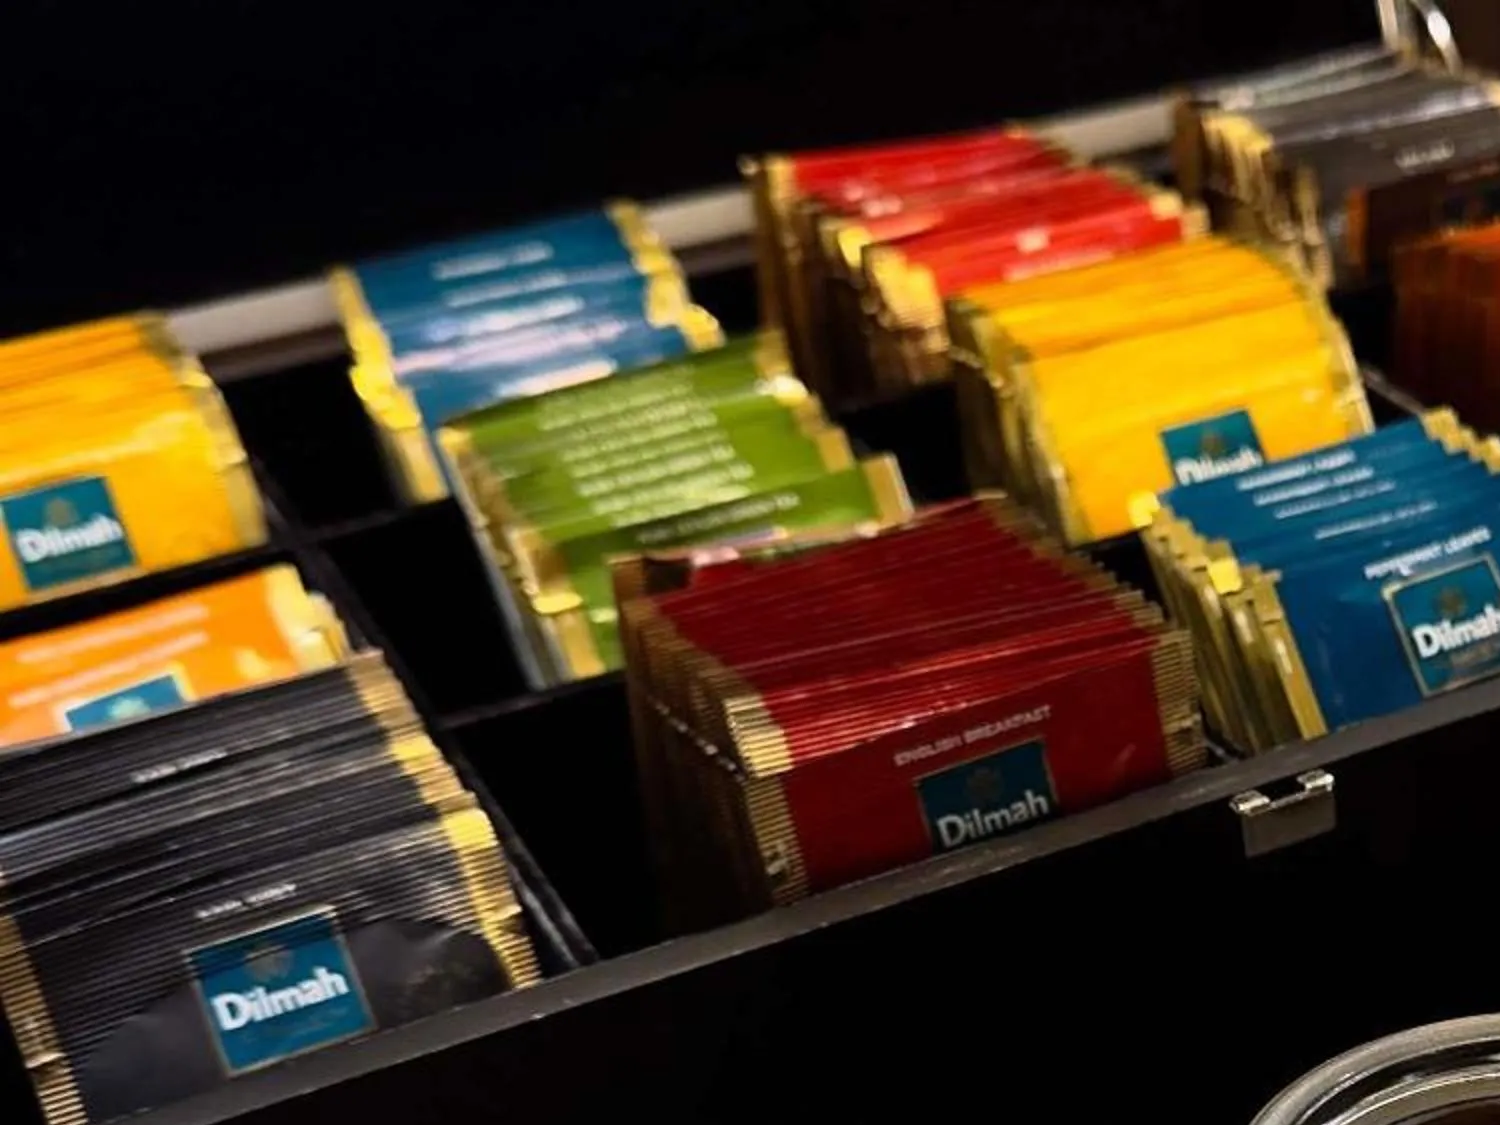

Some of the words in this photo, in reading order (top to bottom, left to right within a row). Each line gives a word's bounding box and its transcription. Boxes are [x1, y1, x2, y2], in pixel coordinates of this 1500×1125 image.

[16, 512, 124, 564] Dilmah
[893, 734, 964, 767] ENGLISH
[961, 703, 1052, 745] BREAKFAST
[937, 788, 1048, 849] Dilmah
[211, 966, 349, 1031] Dilmah
